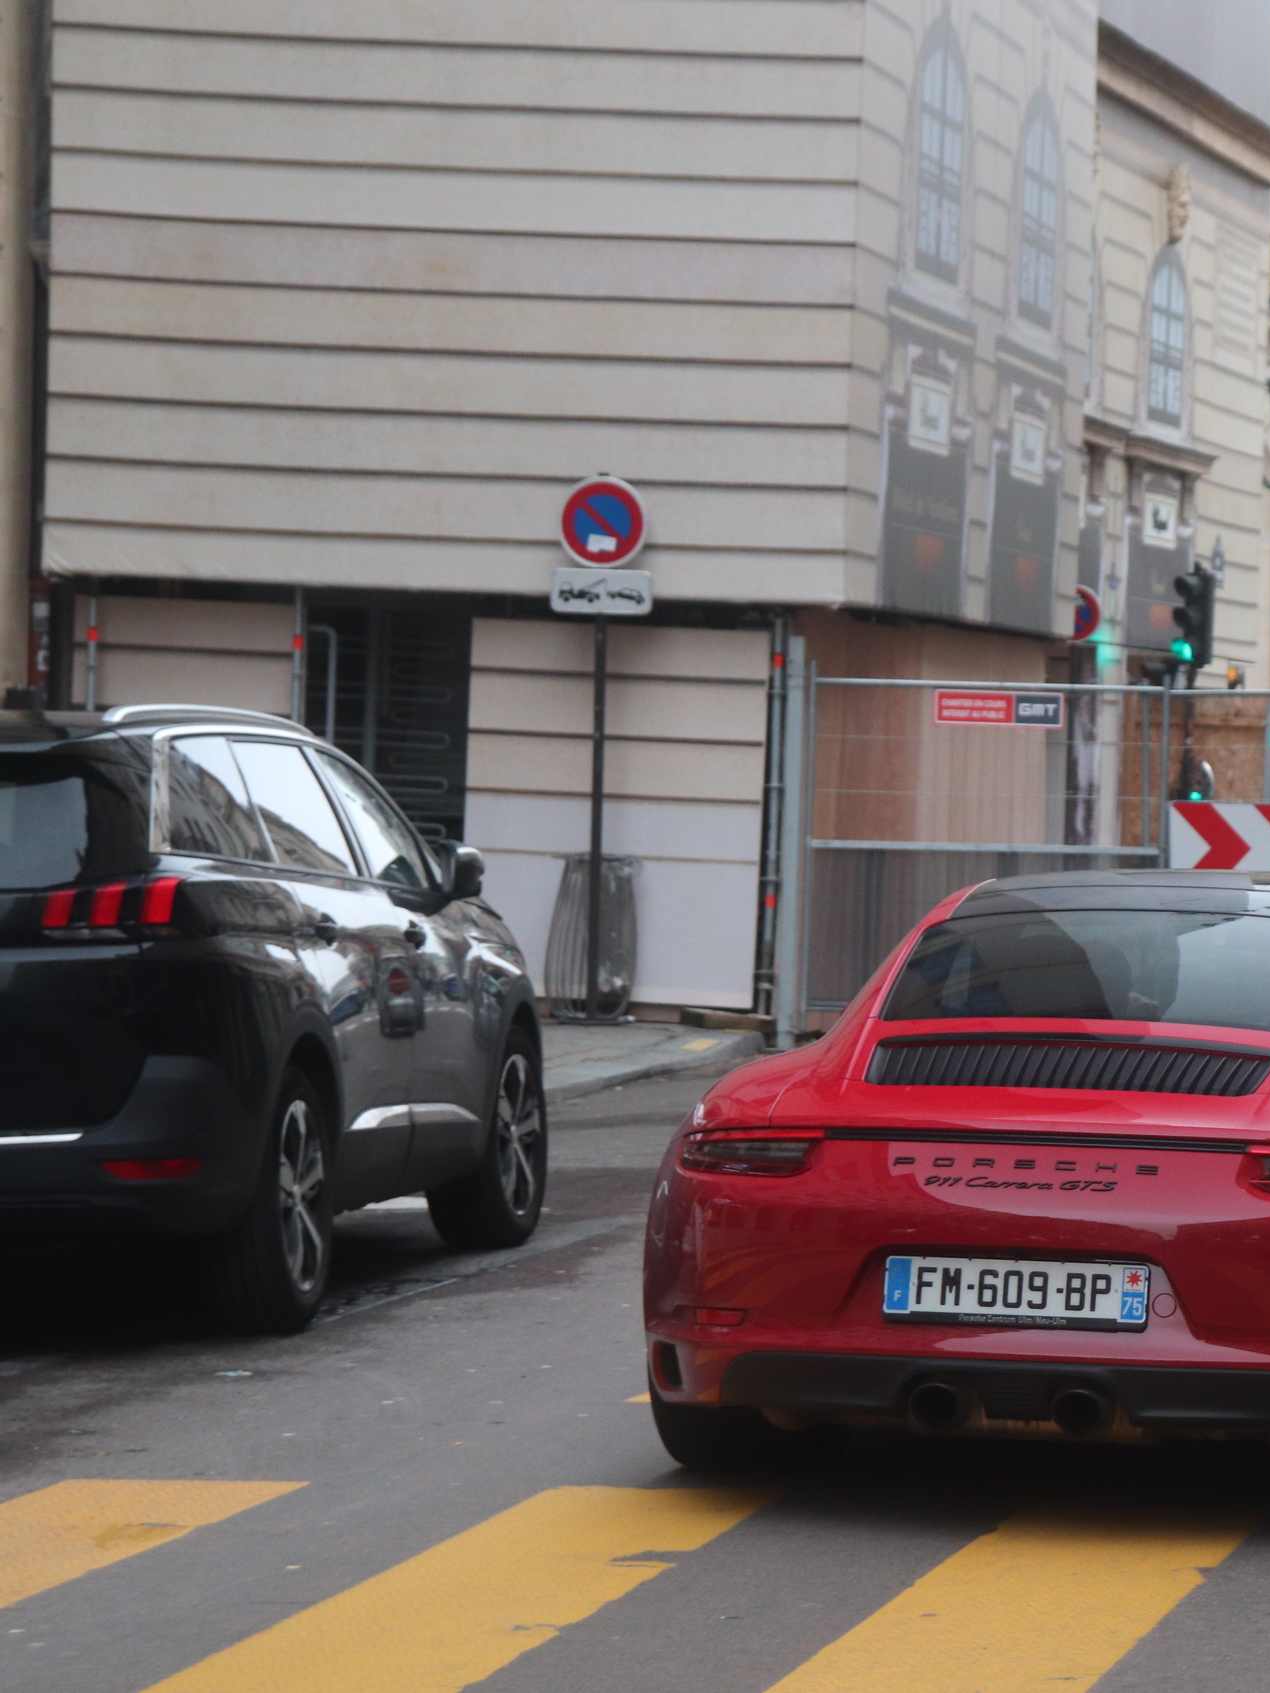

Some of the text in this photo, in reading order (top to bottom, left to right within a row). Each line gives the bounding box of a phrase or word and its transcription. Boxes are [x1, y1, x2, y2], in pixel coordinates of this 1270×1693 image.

[892, 1155, 1160, 1176] PORSCHE
[923, 1175, 1118, 1192] 911 Carrera GTS
[894, 1289, 903, 1302] F
[915, 1265, 1112, 1312] FM-609-BP
[1121, 1296, 1143, 1316] 75
